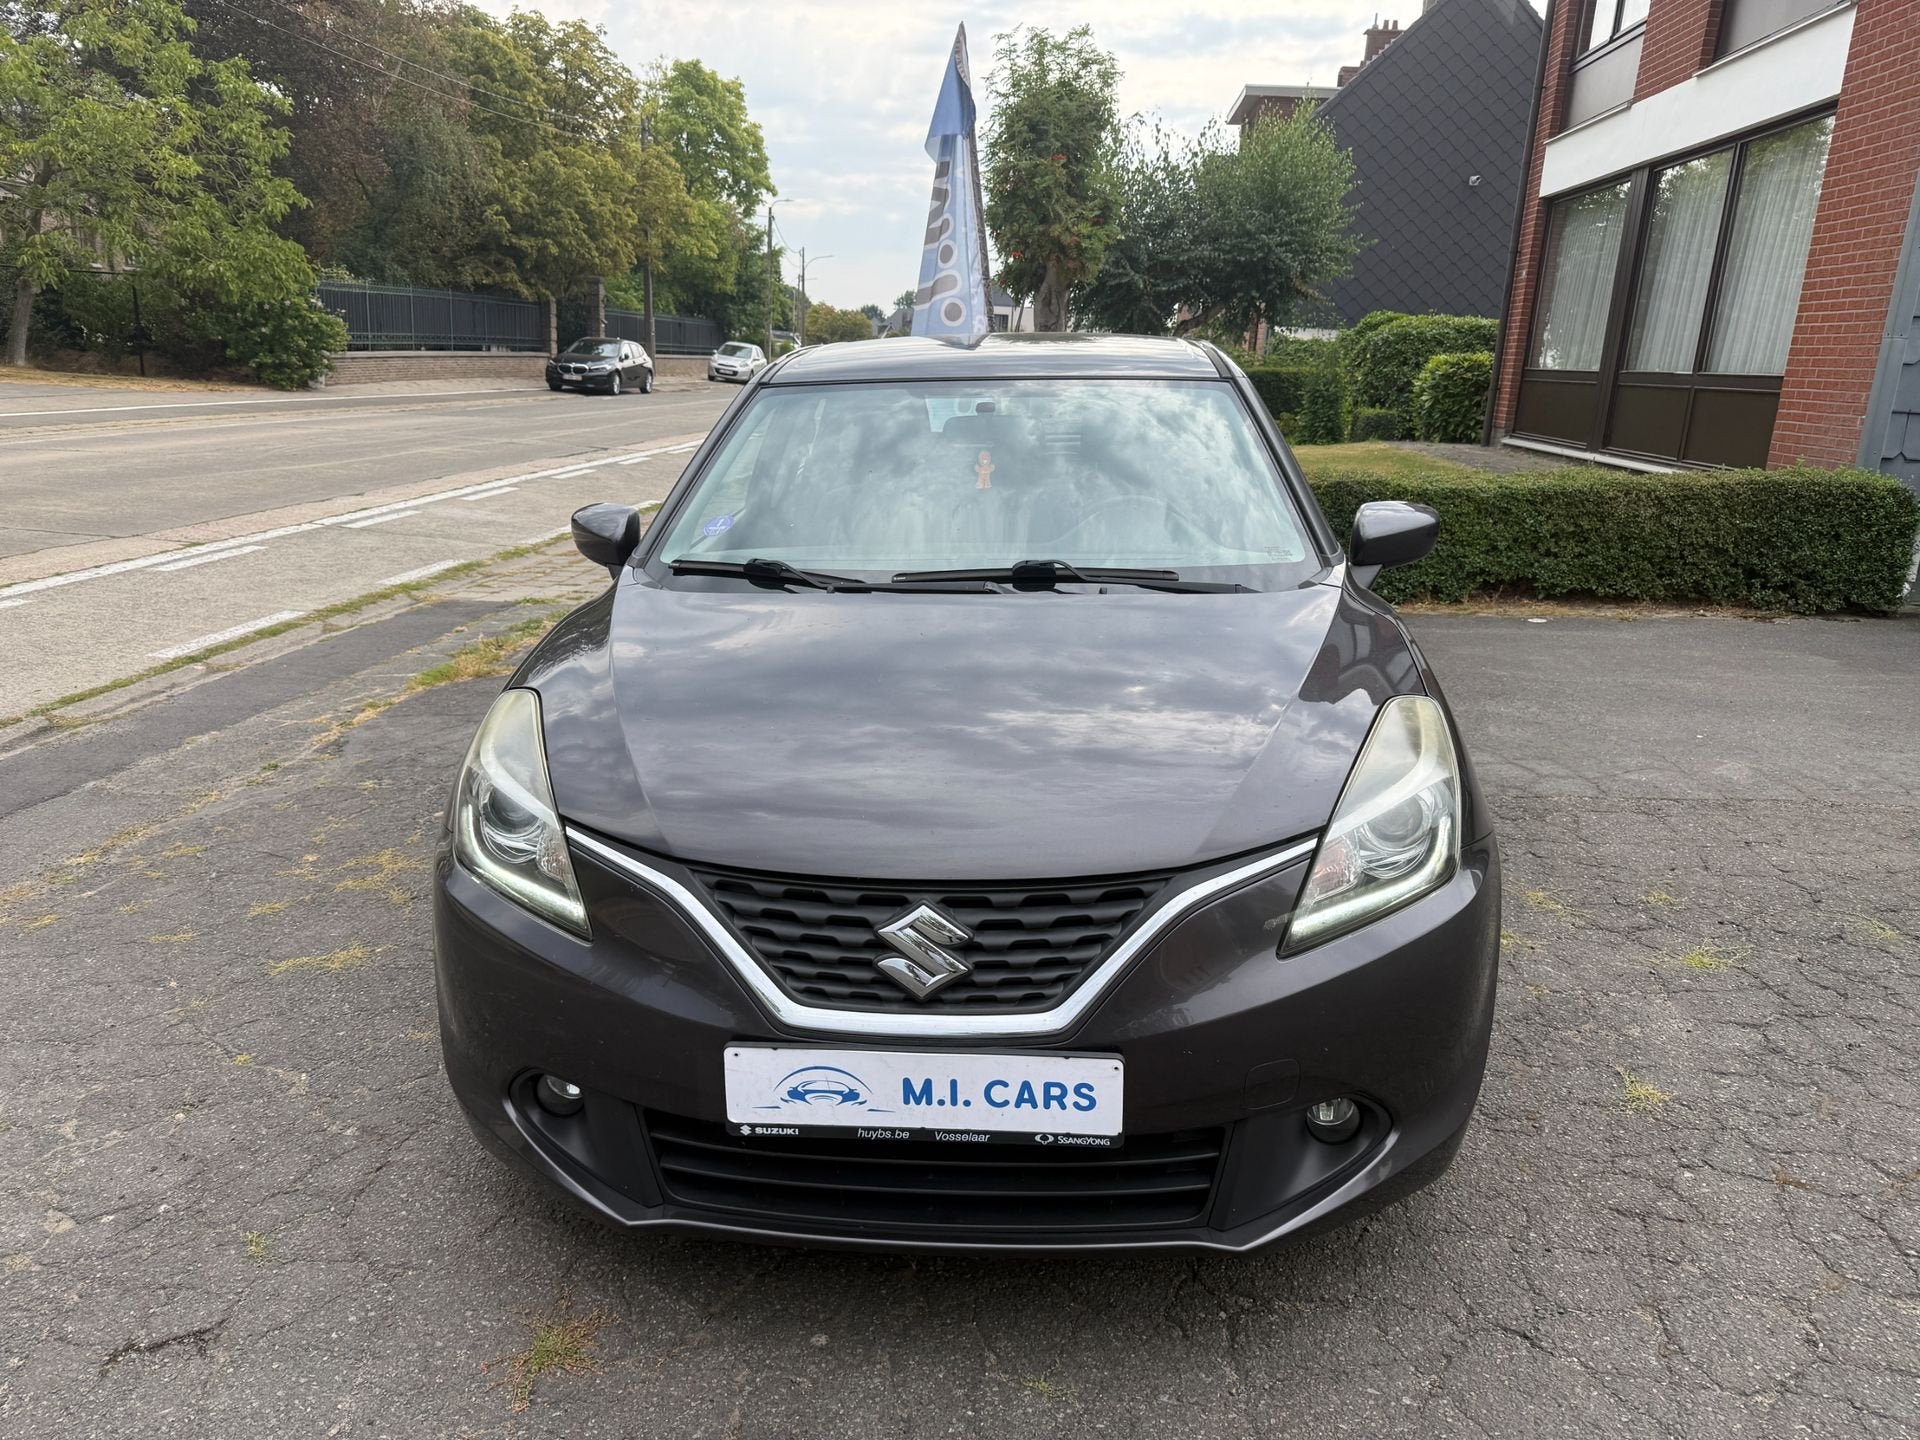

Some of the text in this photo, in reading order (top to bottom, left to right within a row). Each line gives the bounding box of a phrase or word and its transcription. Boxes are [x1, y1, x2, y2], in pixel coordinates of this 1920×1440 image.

[902, 1077, 1097, 1112] M.I. CARS
[755, 1126, 799, 1135] SUZUKI
[857, 1128, 990, 1142] huybs.be Vosselaar
